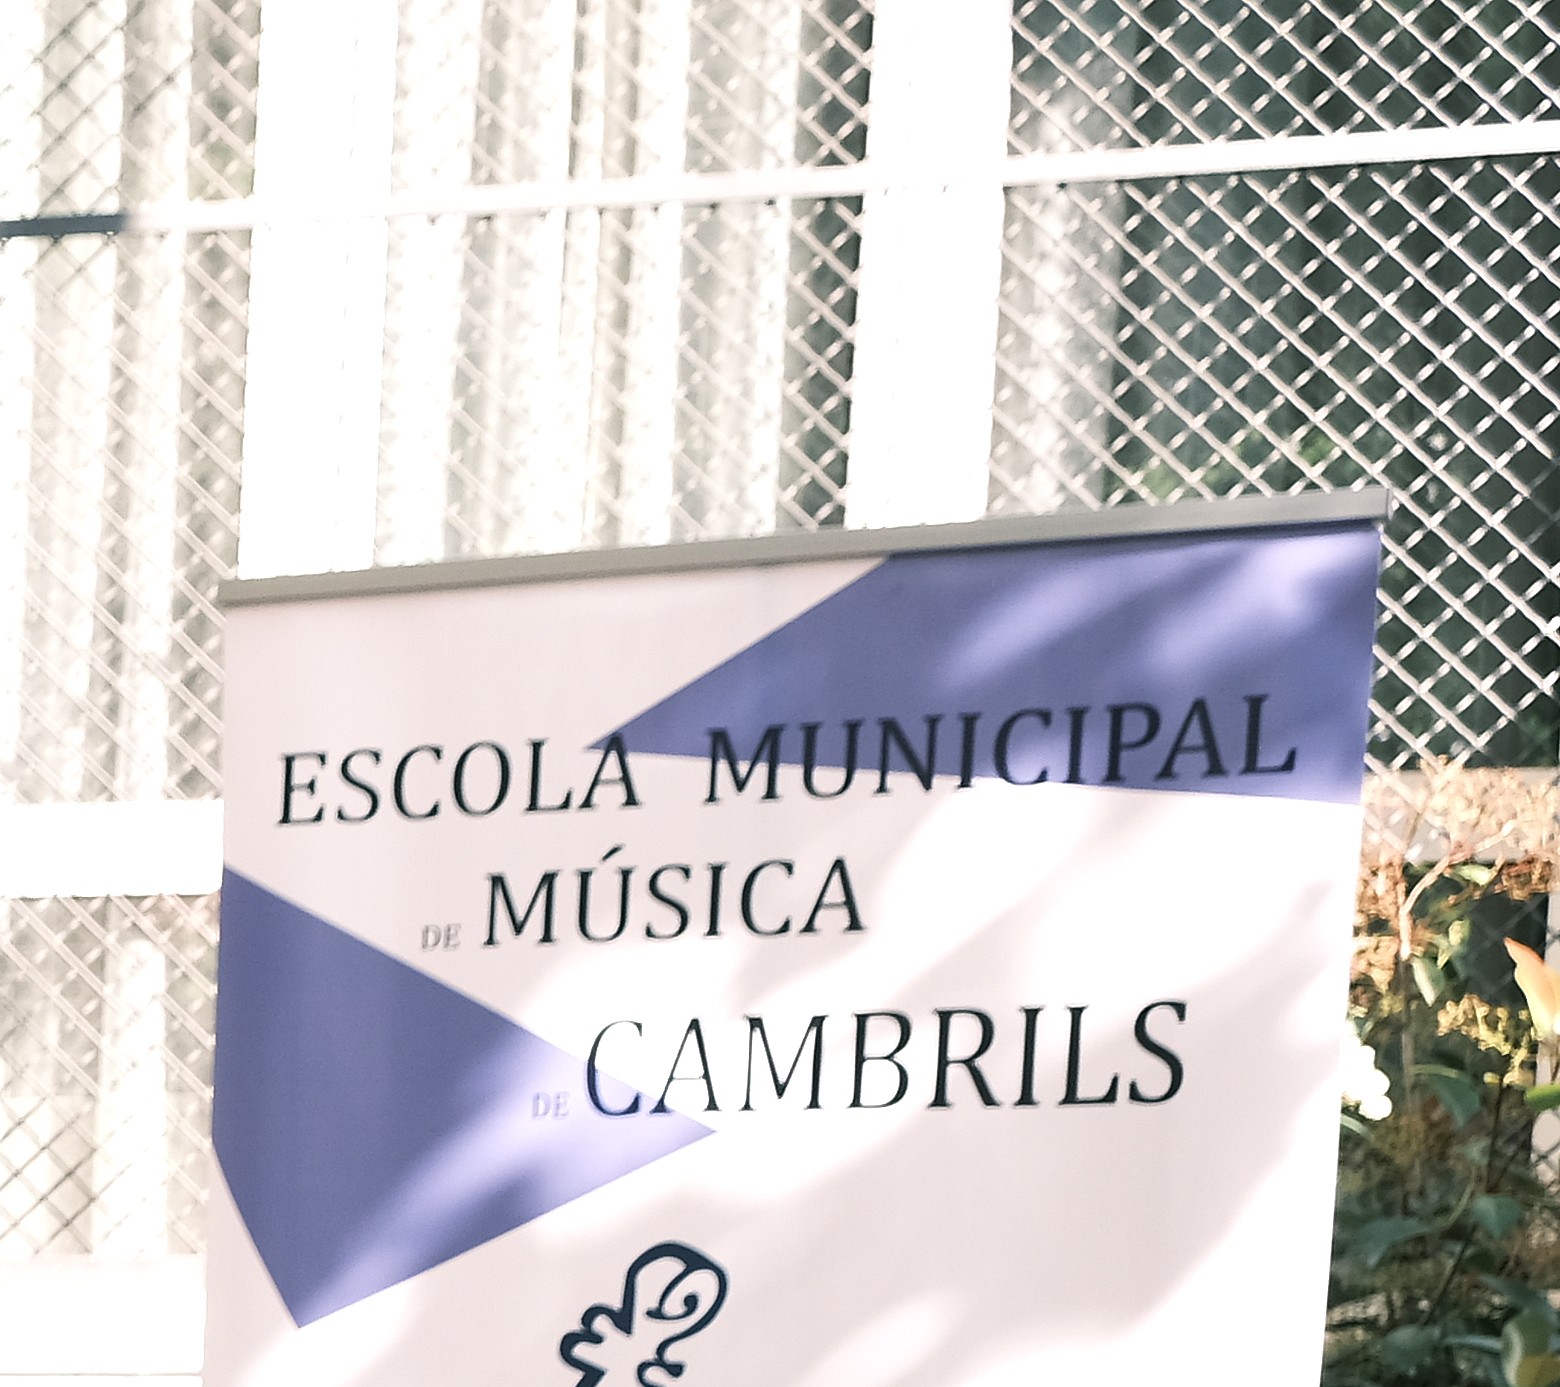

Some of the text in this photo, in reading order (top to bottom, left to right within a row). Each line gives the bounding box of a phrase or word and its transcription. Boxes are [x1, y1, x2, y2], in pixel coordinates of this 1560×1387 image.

[276, 694, 1299, 826] ESCOLA MUNICIPAL
[421, 845, 866, 952] DE MÚSICA
[585, 999, 1189, 1119] CAMBRILS
